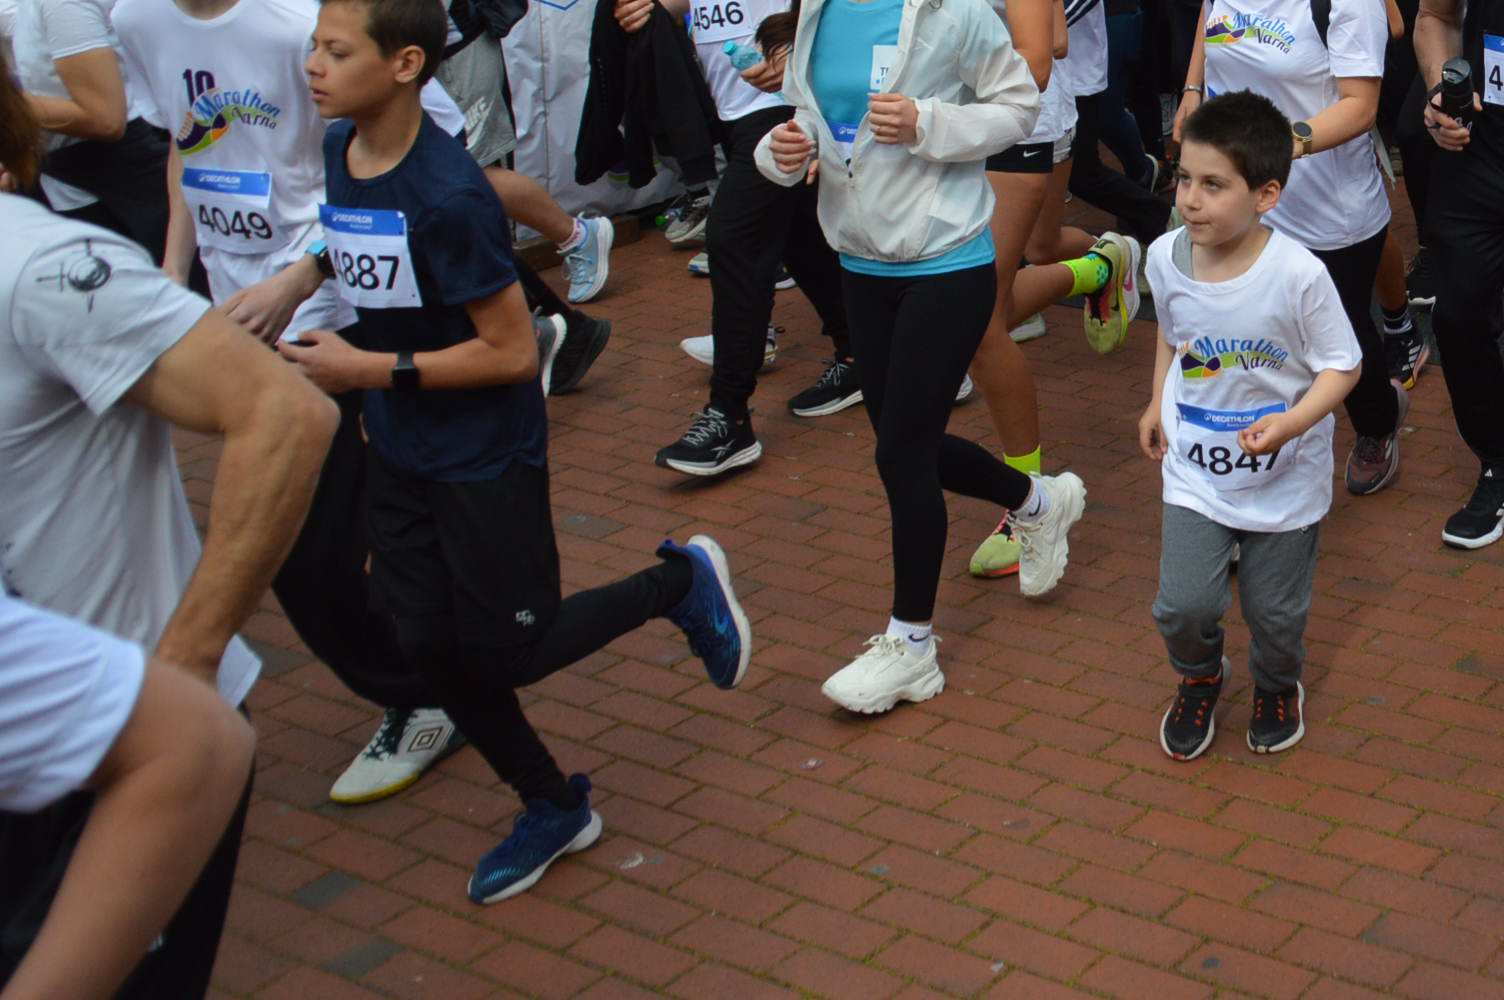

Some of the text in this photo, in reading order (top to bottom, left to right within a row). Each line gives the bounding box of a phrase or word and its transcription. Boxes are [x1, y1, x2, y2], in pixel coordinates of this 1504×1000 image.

[693, 1, 744, 31] 4546
[1255, 28, 1290, 54] Varna
[182, 69, 216, 107] 10
[194, 88, 281, 121] Marathon
[198, 204, 273, 239] 4049
[1194, 335, 1289, 363] Marathon
[1235, 351, 1284, 372] Varna
